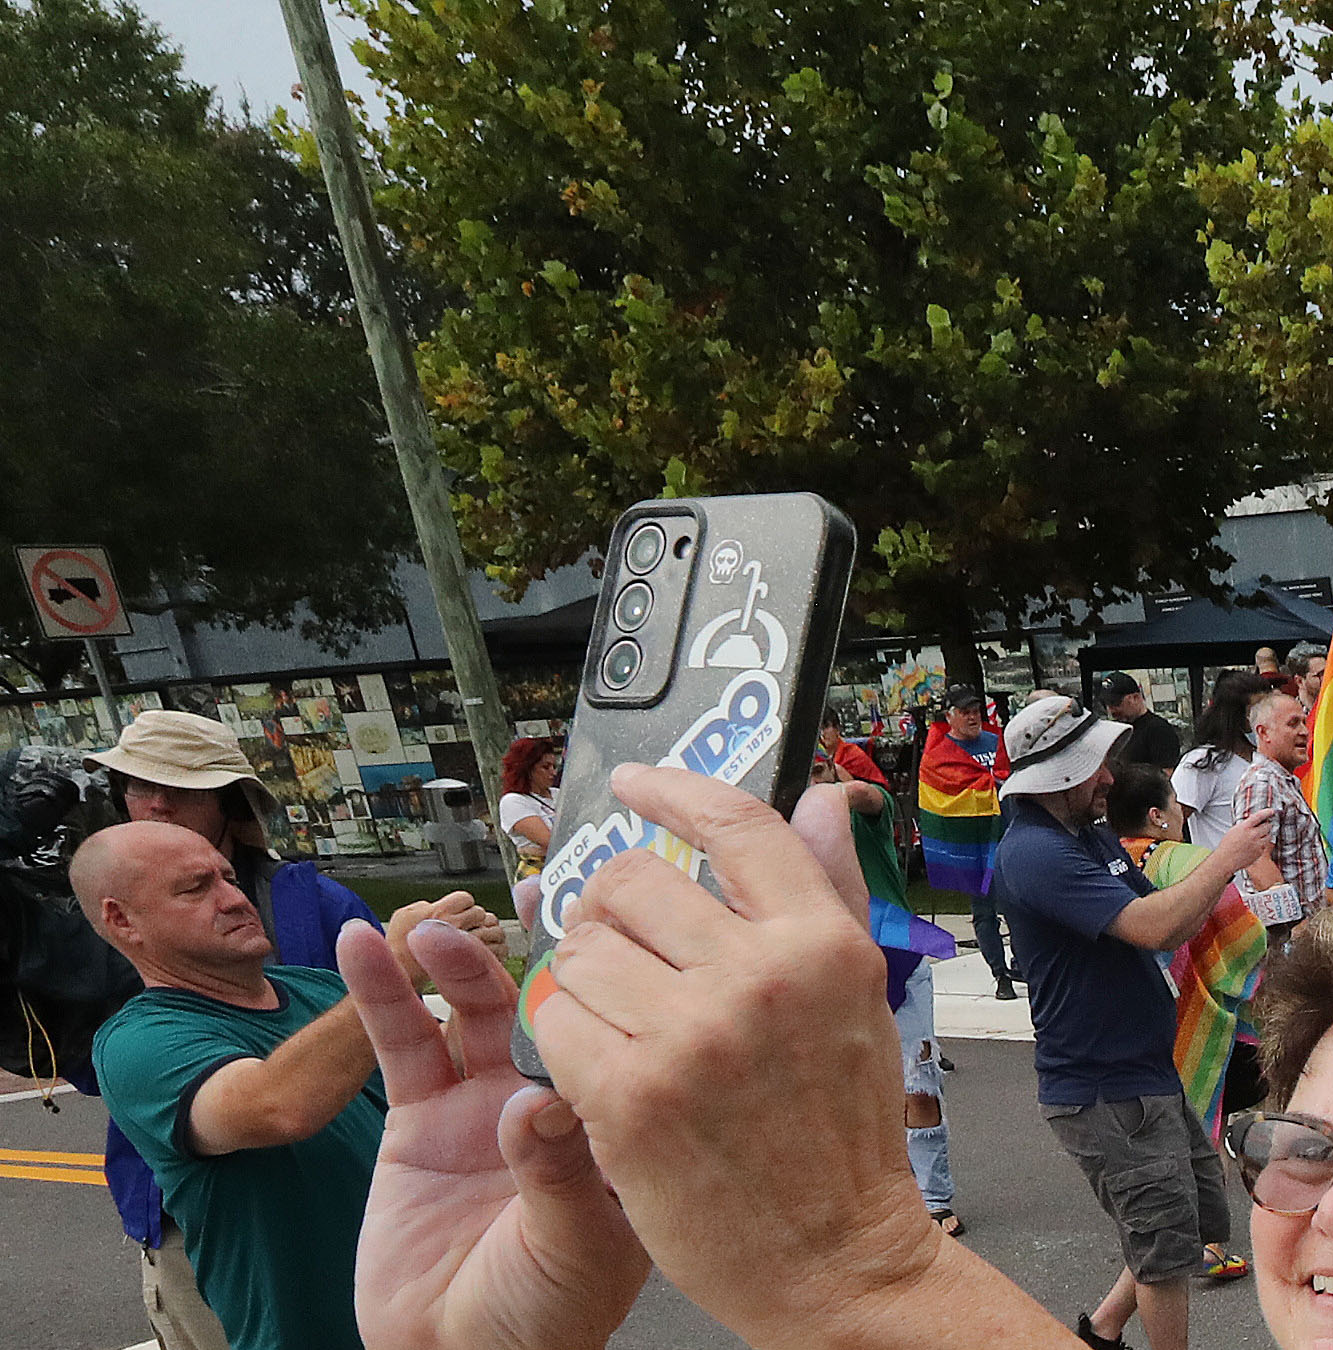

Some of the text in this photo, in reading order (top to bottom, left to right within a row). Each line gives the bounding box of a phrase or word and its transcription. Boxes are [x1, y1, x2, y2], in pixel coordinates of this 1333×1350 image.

[723, 724, 773, 780] EST. 1875
[548, 835, 590, 886] CITY OF
[1264, 894, 1277, 920] PLAY
